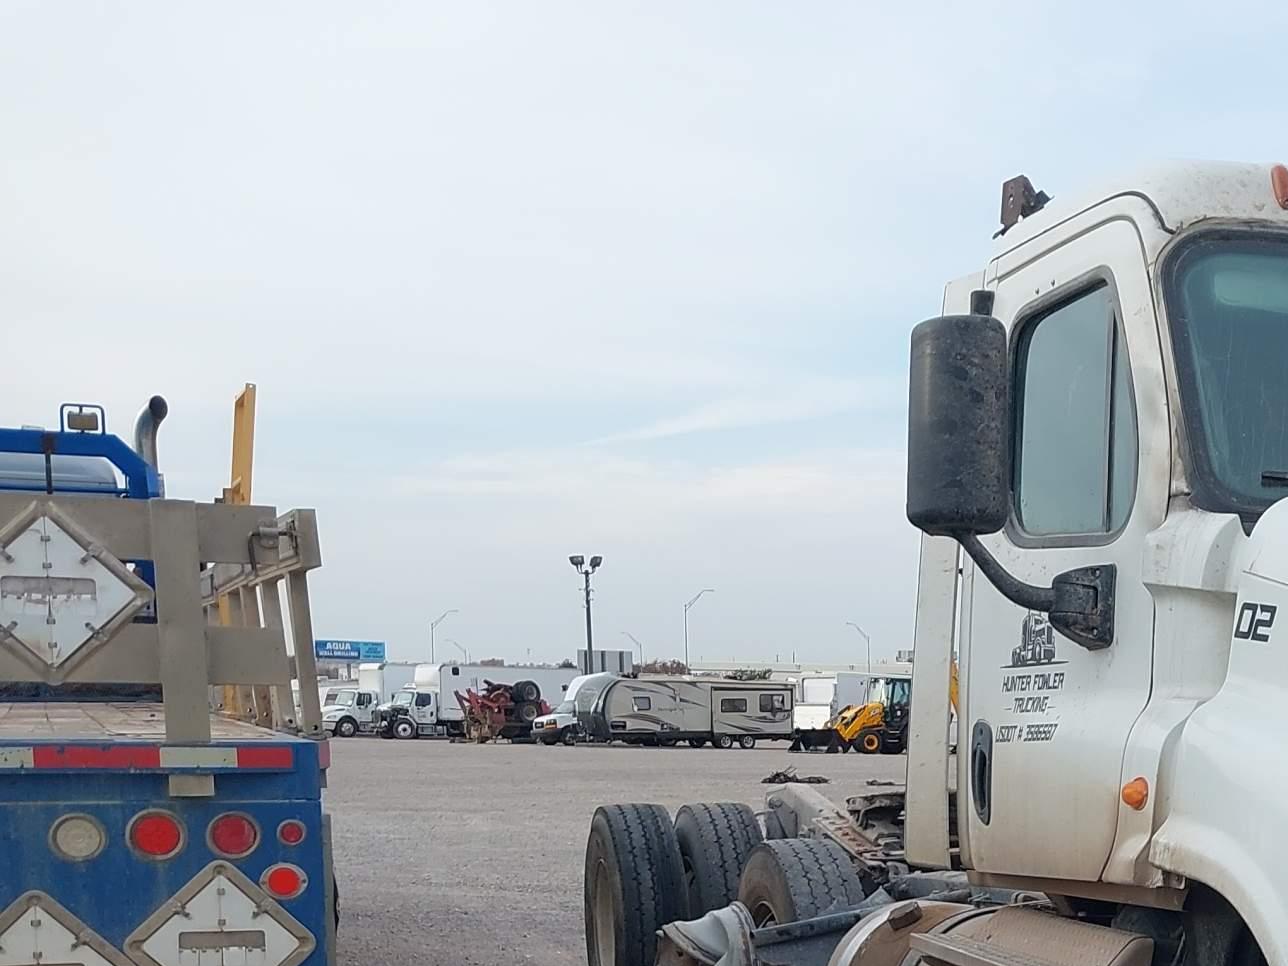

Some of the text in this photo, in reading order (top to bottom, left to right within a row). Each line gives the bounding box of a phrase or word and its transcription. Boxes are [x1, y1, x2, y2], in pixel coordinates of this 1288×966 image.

[1234, 602, 1278, 642] 02
[325, 642, 352, 651] AQUA
[1002, 673, 1065, 693] HUNTER FOWLER
[1013, 696, 1049, 713] TRUCKING
[995, 725, 1018, 743] USDOT
